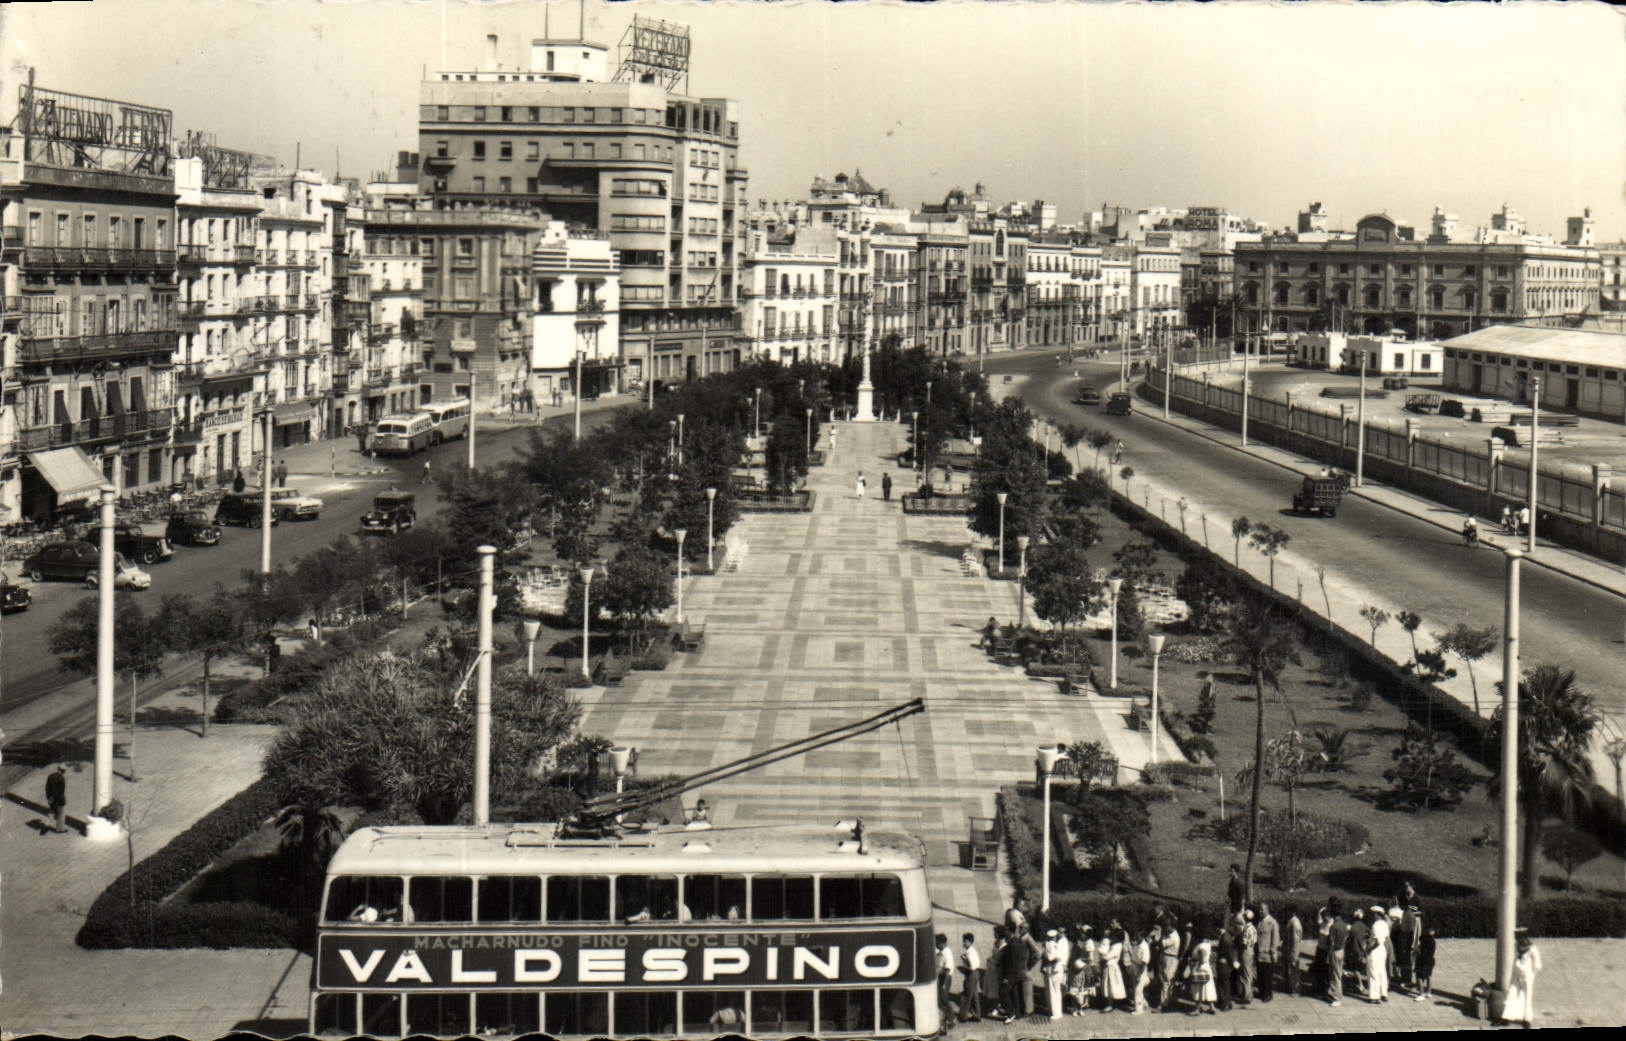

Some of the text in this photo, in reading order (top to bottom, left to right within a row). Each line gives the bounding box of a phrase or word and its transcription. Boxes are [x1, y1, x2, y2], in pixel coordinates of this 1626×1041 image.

[1188, 207, 1219, 216] HOTEL
[1188, 218, 1219, 229] ROMA
[414, 932, 812, 949] MACHARNUDO FINO "INOCENTE"
[338, 945, 900, 983] VALDESPINO
